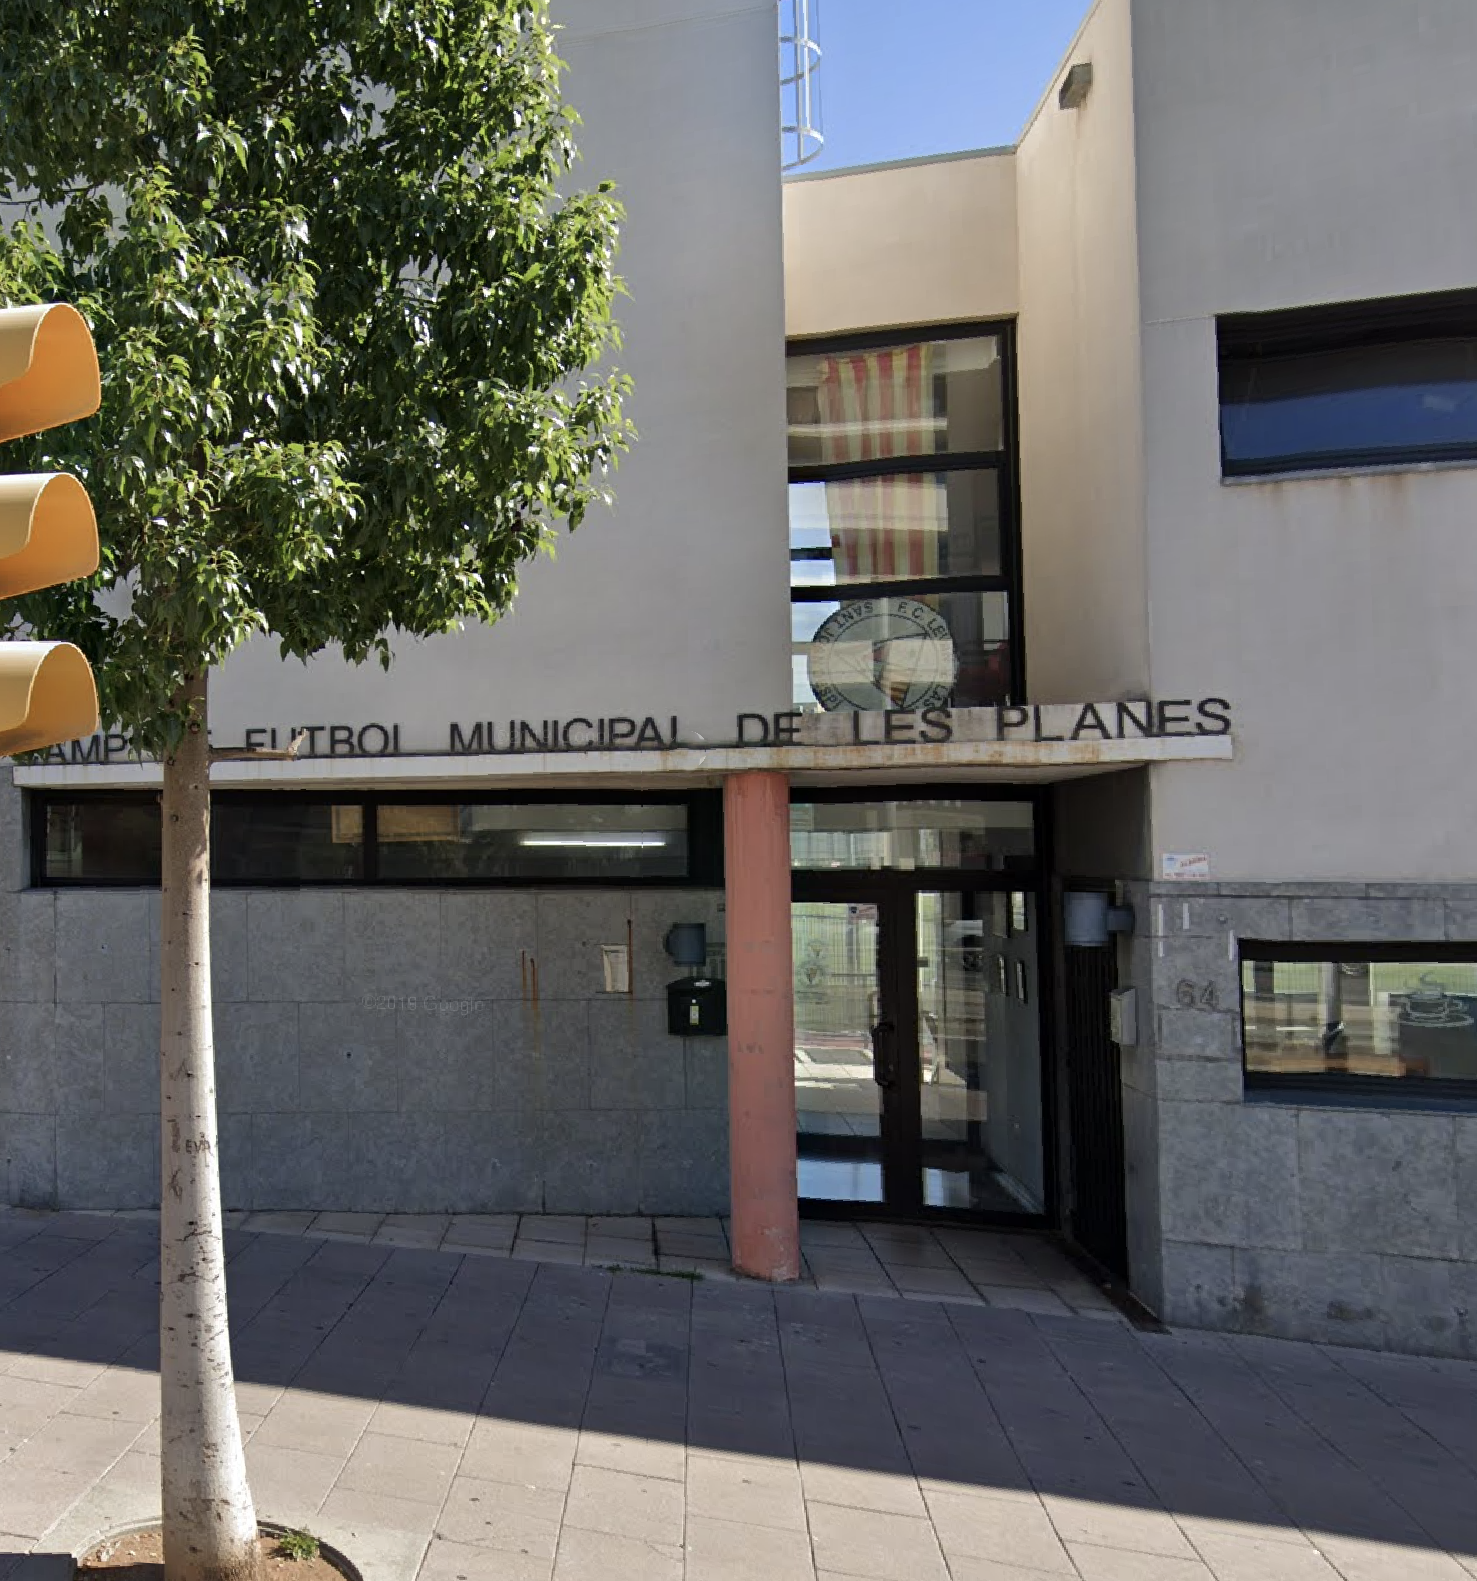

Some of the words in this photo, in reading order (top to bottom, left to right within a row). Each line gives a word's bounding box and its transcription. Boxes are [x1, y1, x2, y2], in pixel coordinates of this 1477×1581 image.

[30, 732, 129, 765] AMP
[245, 722, 404, 755] FUTBOL
[448, 715, 690, 753] MUNICIPAL
[736, 710, 804, 748] DE
[852, 706, 953, 745] LES
[996, 697, 1232, 742] PLANES
[1176, 977, 1217, 1007] 64
